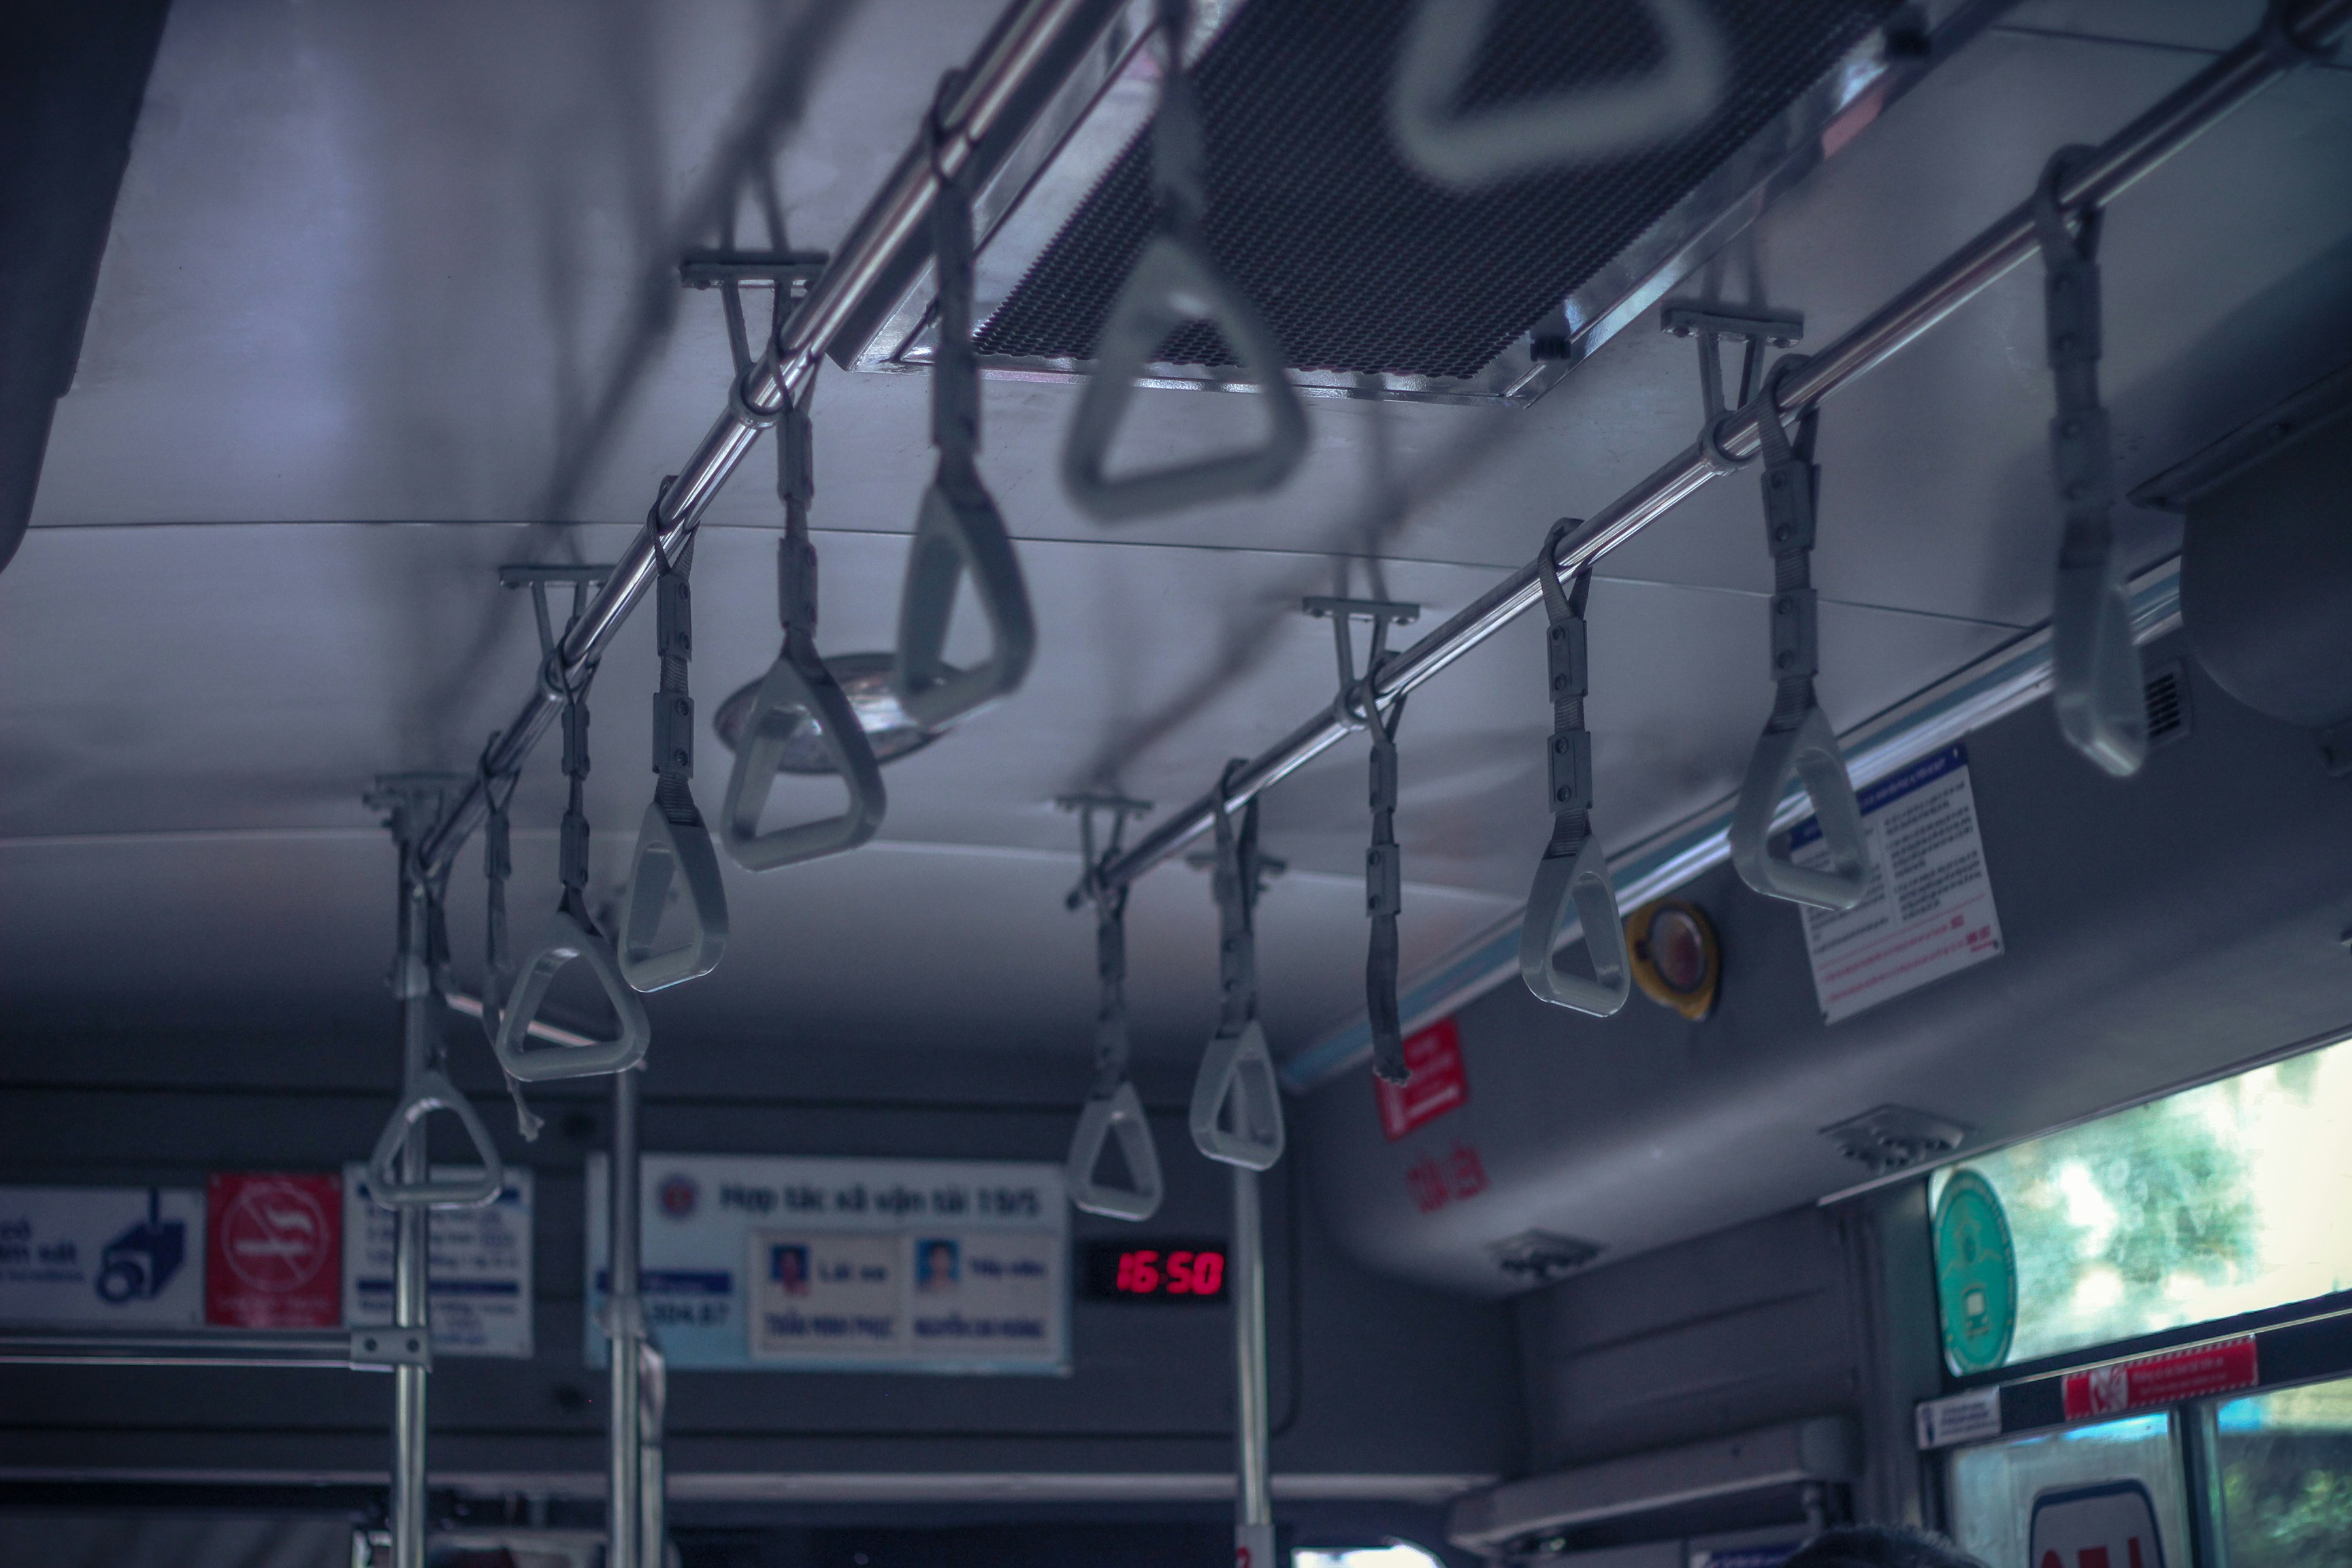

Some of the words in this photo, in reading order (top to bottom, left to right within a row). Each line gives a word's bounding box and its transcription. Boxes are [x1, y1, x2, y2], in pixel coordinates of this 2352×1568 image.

[719, 1183, 778, 1215] Hợp
[784, 1184, 827, 1212] tác
[834, 1183, 868, 1212] xã
[874, 1184, 925, 1218] vận
[932, 1185, 969, 1215] tải
[977, 1187, 1040, 1217] 19/5
